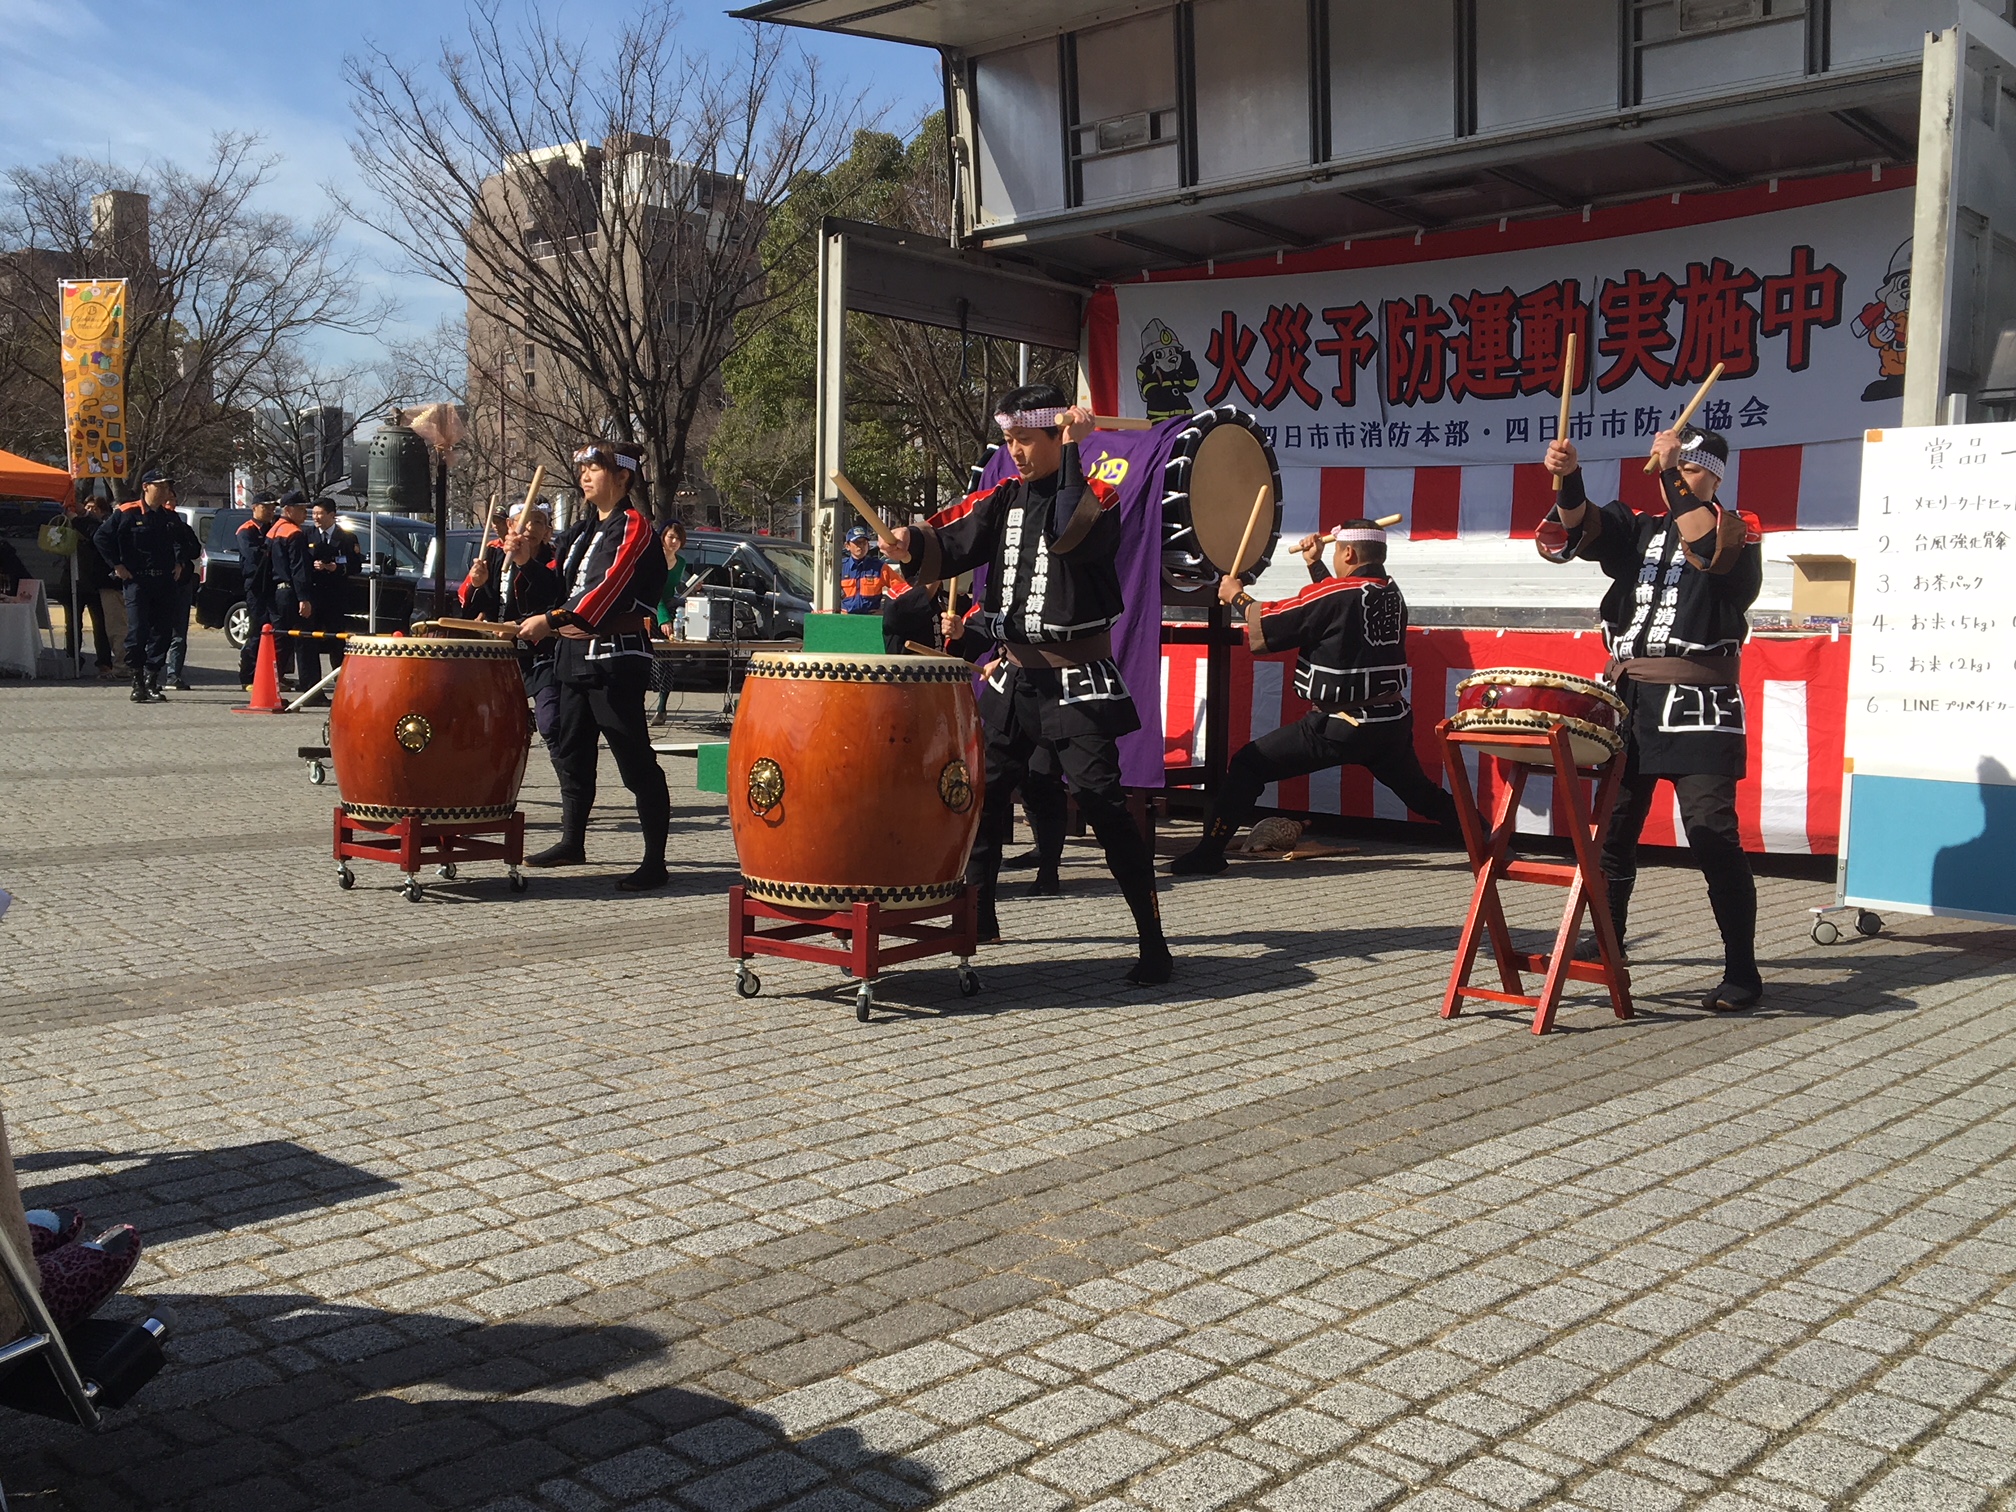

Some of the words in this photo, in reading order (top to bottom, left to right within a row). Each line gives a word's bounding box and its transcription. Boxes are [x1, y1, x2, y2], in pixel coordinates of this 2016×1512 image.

[1204, 245, 1847, 412] 火災予防運動実施中
[1915, 495, 2016, 511] メモリーカードセッ
[1913, 573, 1983, 592] お茶パック
[1646, 542, 1687, 658] 日市市消防団
[1903, 698, 1940, 711] LINE
